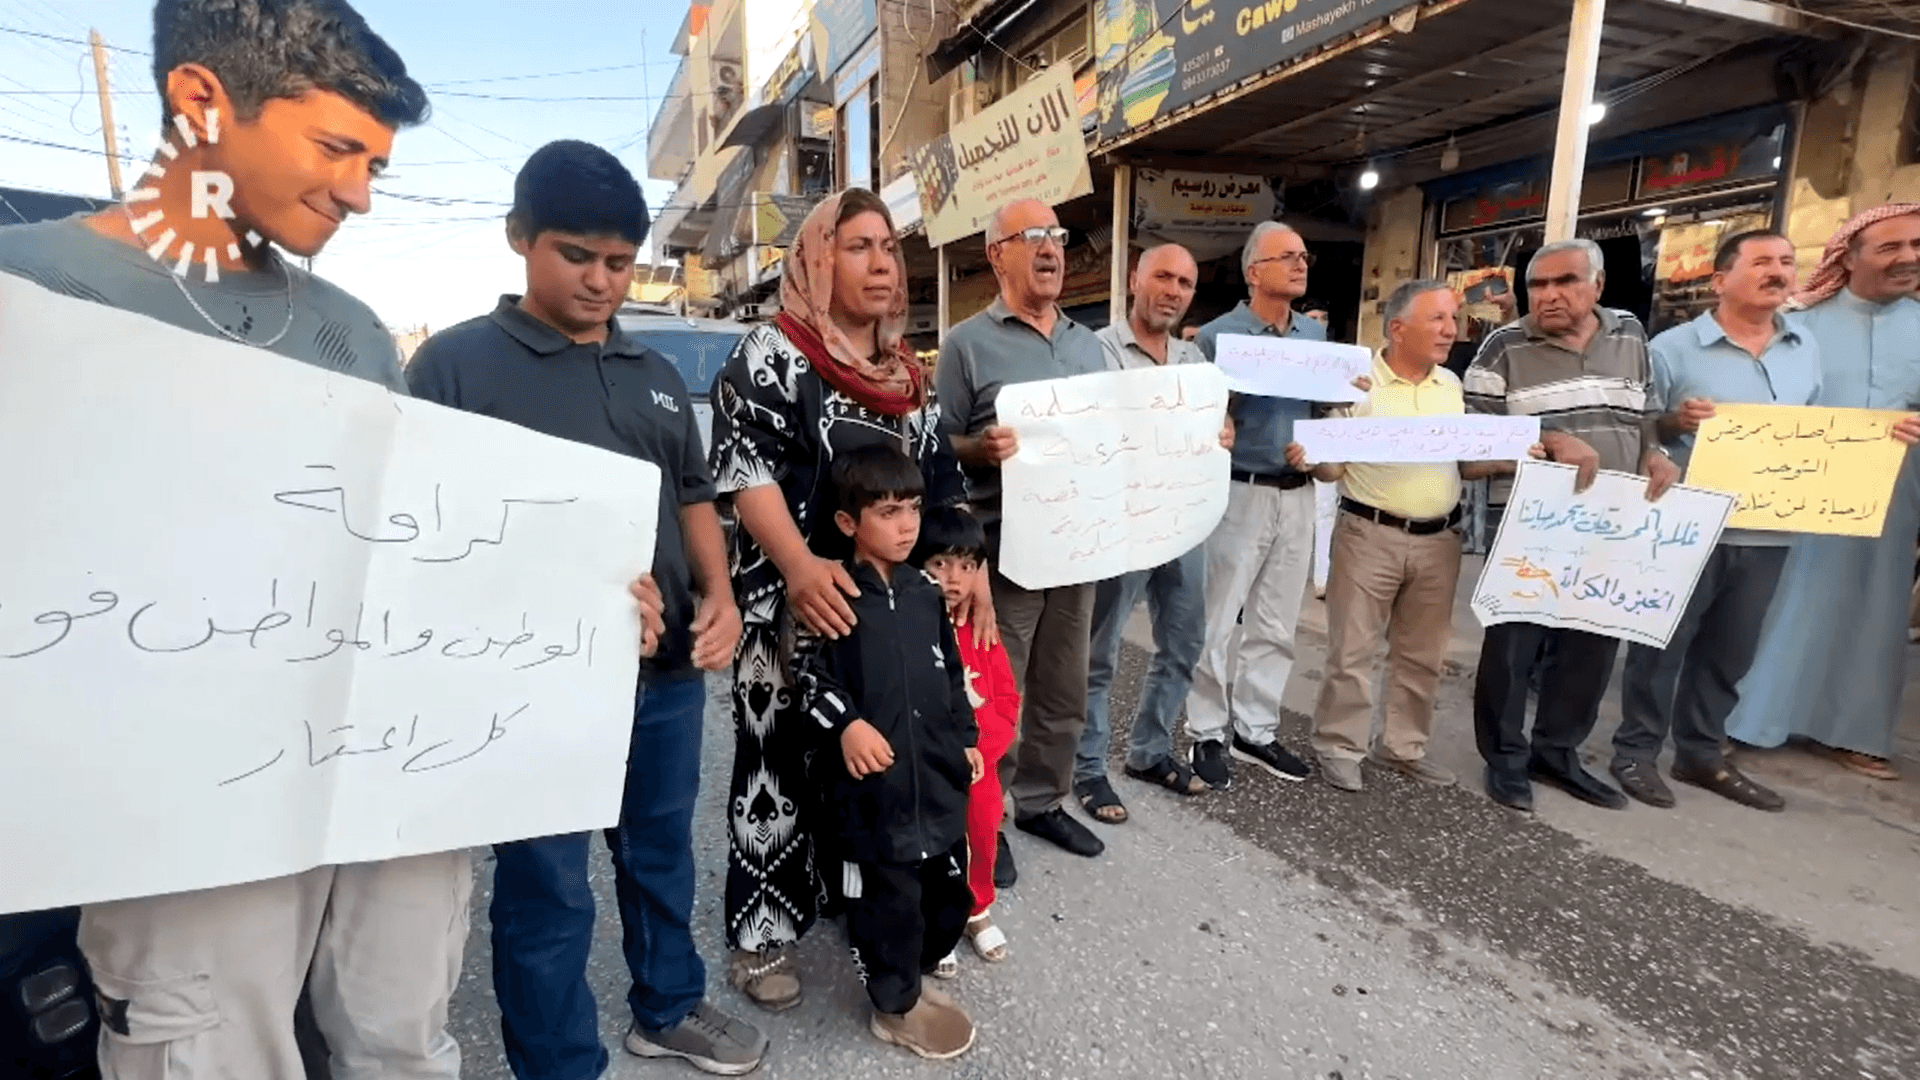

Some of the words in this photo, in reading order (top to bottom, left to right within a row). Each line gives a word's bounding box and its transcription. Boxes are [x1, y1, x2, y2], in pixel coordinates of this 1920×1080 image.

[958, 113, 1020, 173] للتجميل
[1823, 421, 1892, 450] لشعب
[273, 463, 578, 563] كرامة
[0, 571, 119, 658] فو
[127, 577, 434, 665] والمواطن
[441, 611, 597, 670] الوطن
[402, 702, 531, 774] كل
